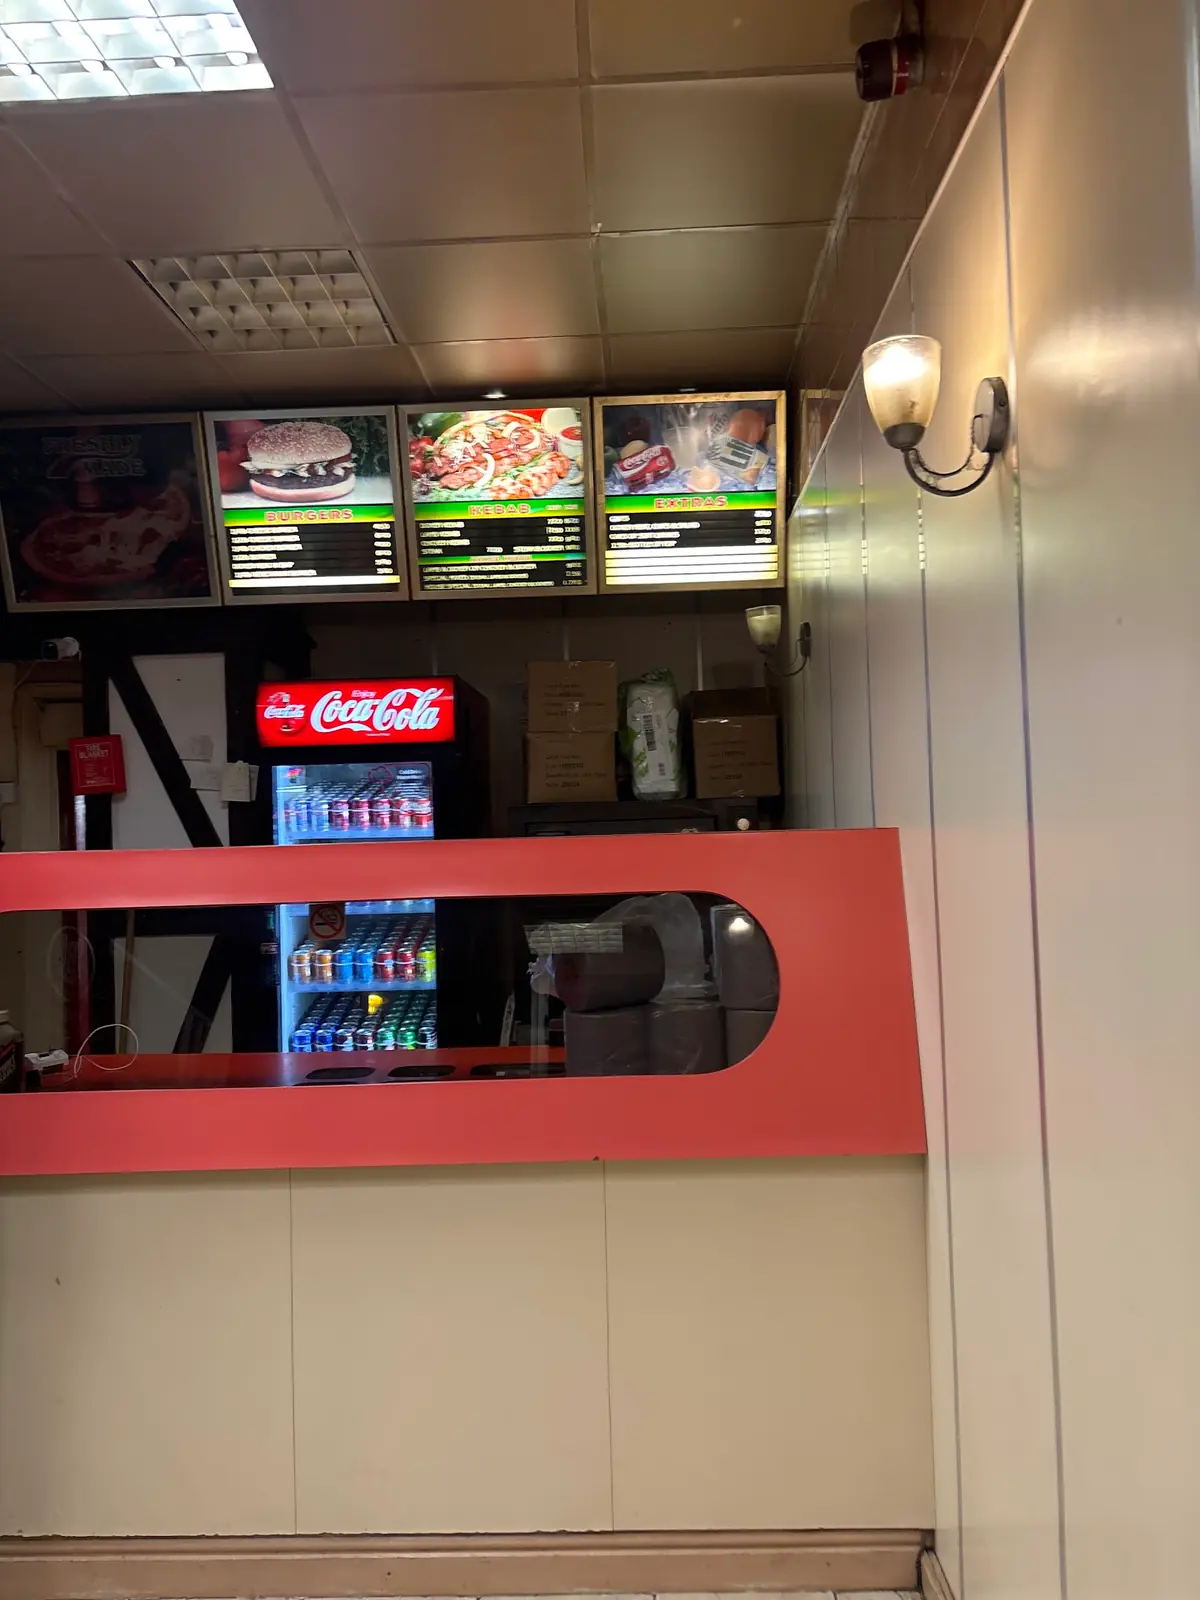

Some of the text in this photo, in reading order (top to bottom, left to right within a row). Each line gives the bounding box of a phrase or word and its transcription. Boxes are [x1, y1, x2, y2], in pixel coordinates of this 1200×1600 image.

[654, 496, 728, 509] EXTRAS
[264, 509, 353, 522] BURGERS
[468, 504, 531, 516] KEBAB
